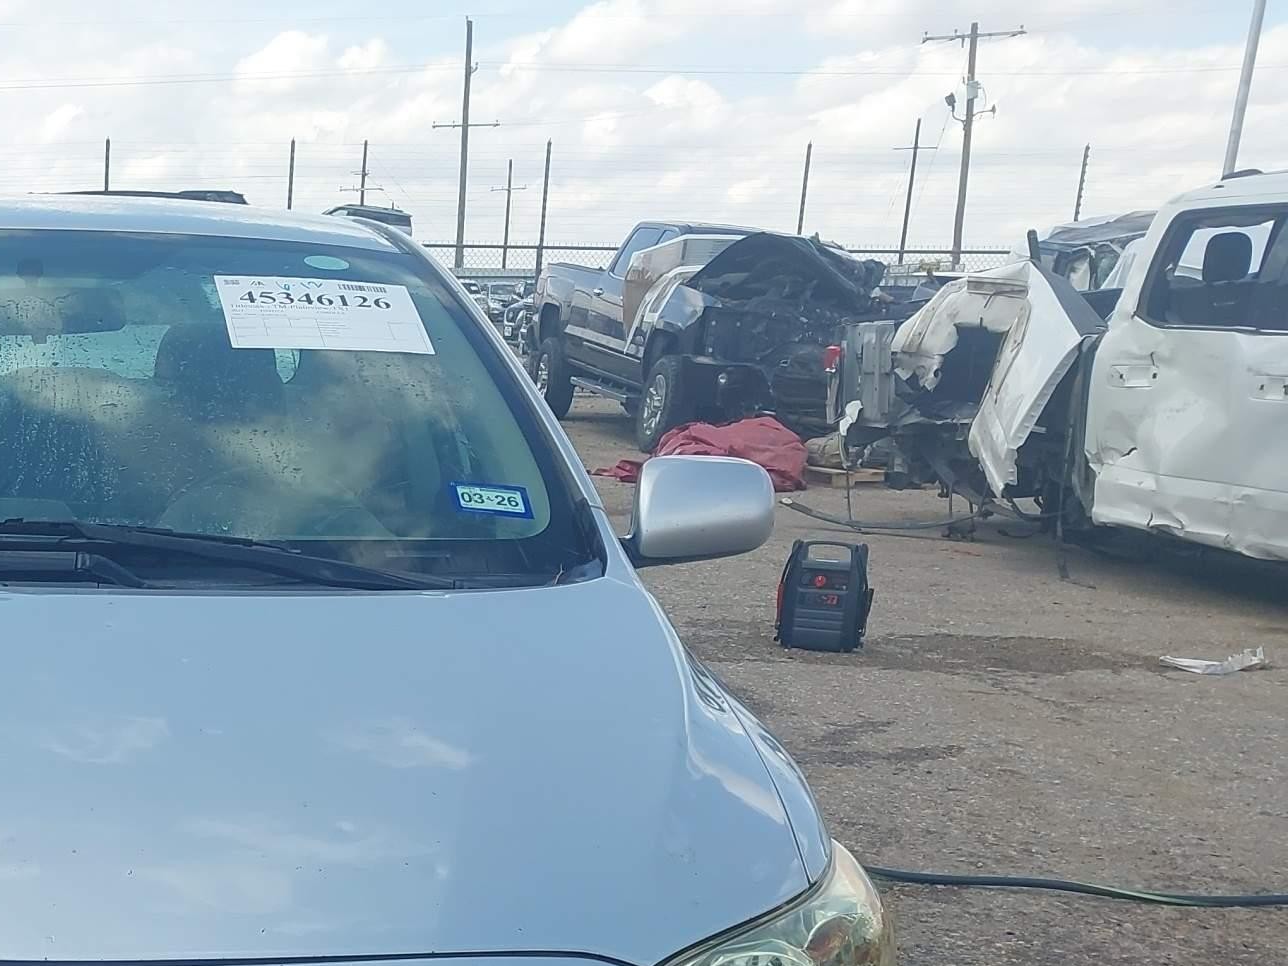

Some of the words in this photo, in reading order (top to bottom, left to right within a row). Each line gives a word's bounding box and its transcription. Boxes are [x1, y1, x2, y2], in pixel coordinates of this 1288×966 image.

[239, 290, 392, 310] 45346126
[460, 492, 486, 505] 03
[494, 495, 520, 508] 26
